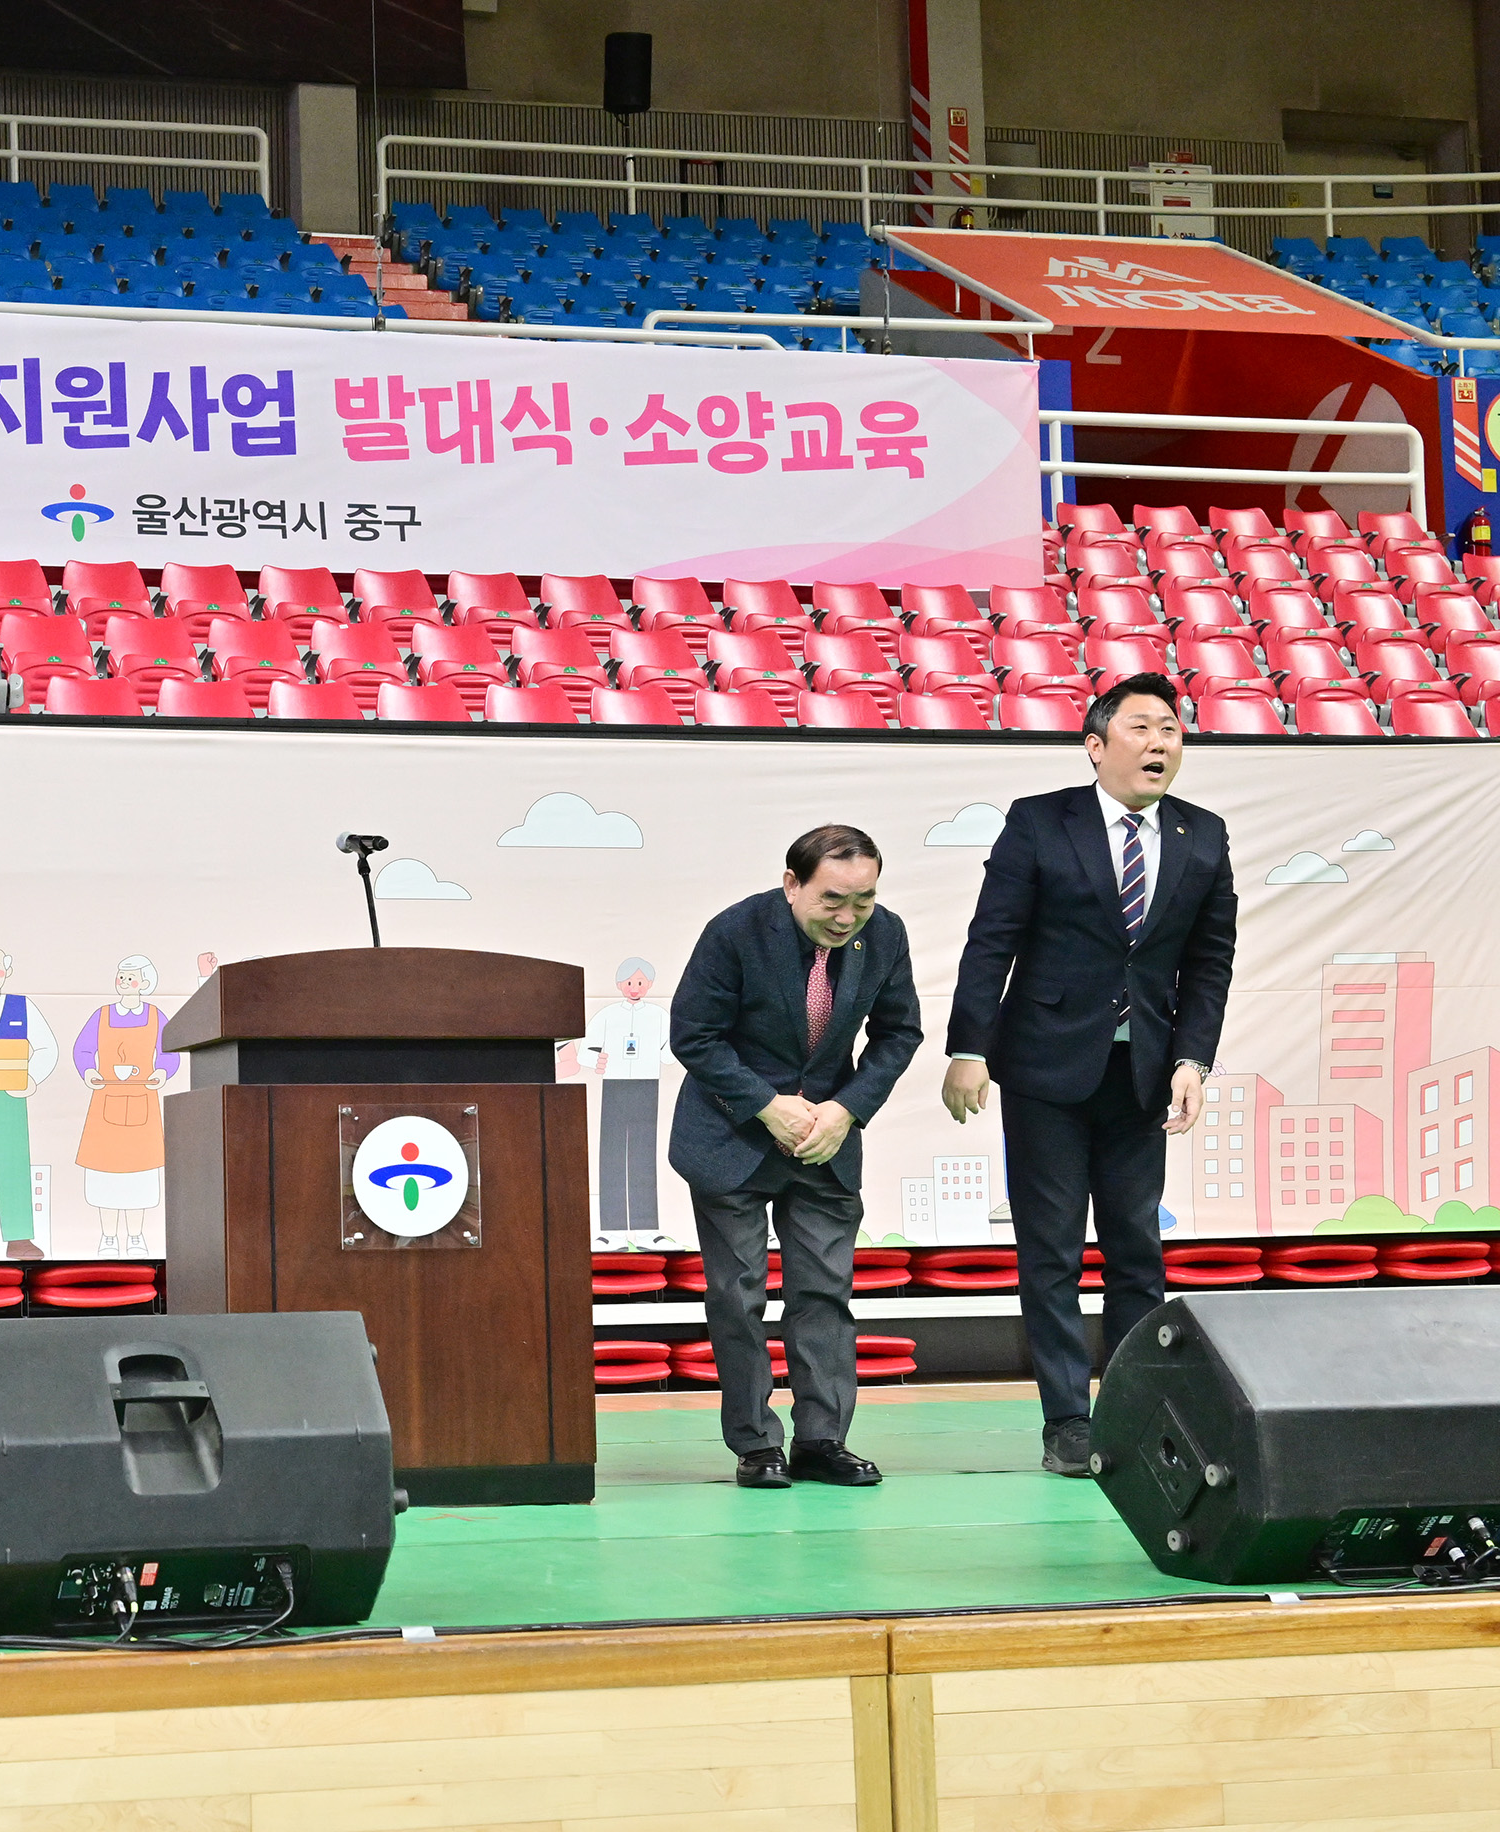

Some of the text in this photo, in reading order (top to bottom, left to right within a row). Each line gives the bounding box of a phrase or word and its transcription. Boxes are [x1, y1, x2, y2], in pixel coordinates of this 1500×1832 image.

[334, 375, 929, 479] 발대식·소양교육
[132, 494, 422, 542] 울산광역시 중구
